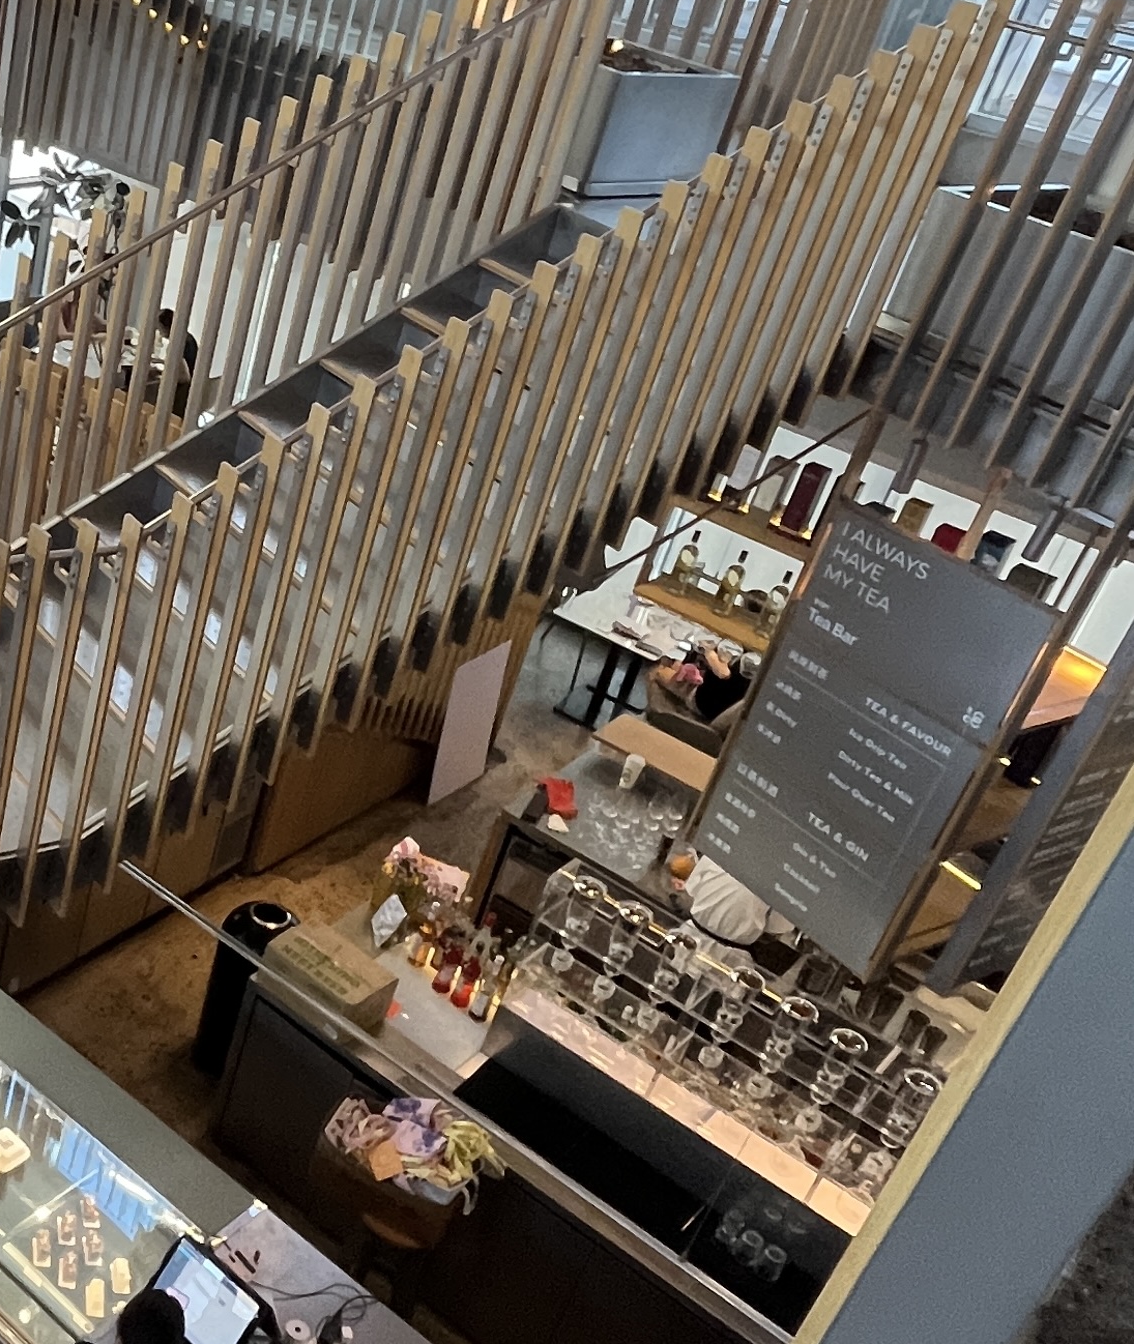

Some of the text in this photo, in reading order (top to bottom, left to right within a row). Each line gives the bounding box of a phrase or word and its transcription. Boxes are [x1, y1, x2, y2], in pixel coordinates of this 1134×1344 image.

[832, 543, 885, 583] HAVE
[841, 521, 931, 580] I ALWAYS
[823, 563, 854, 589] MY
[857, 580, 890, 614] TEA
[809, 606, 858, 646] Tea Bar
[865, 697, 952, 757] TEA & FAVOUR
[808, 811, 869, 862] TEA & GIN
